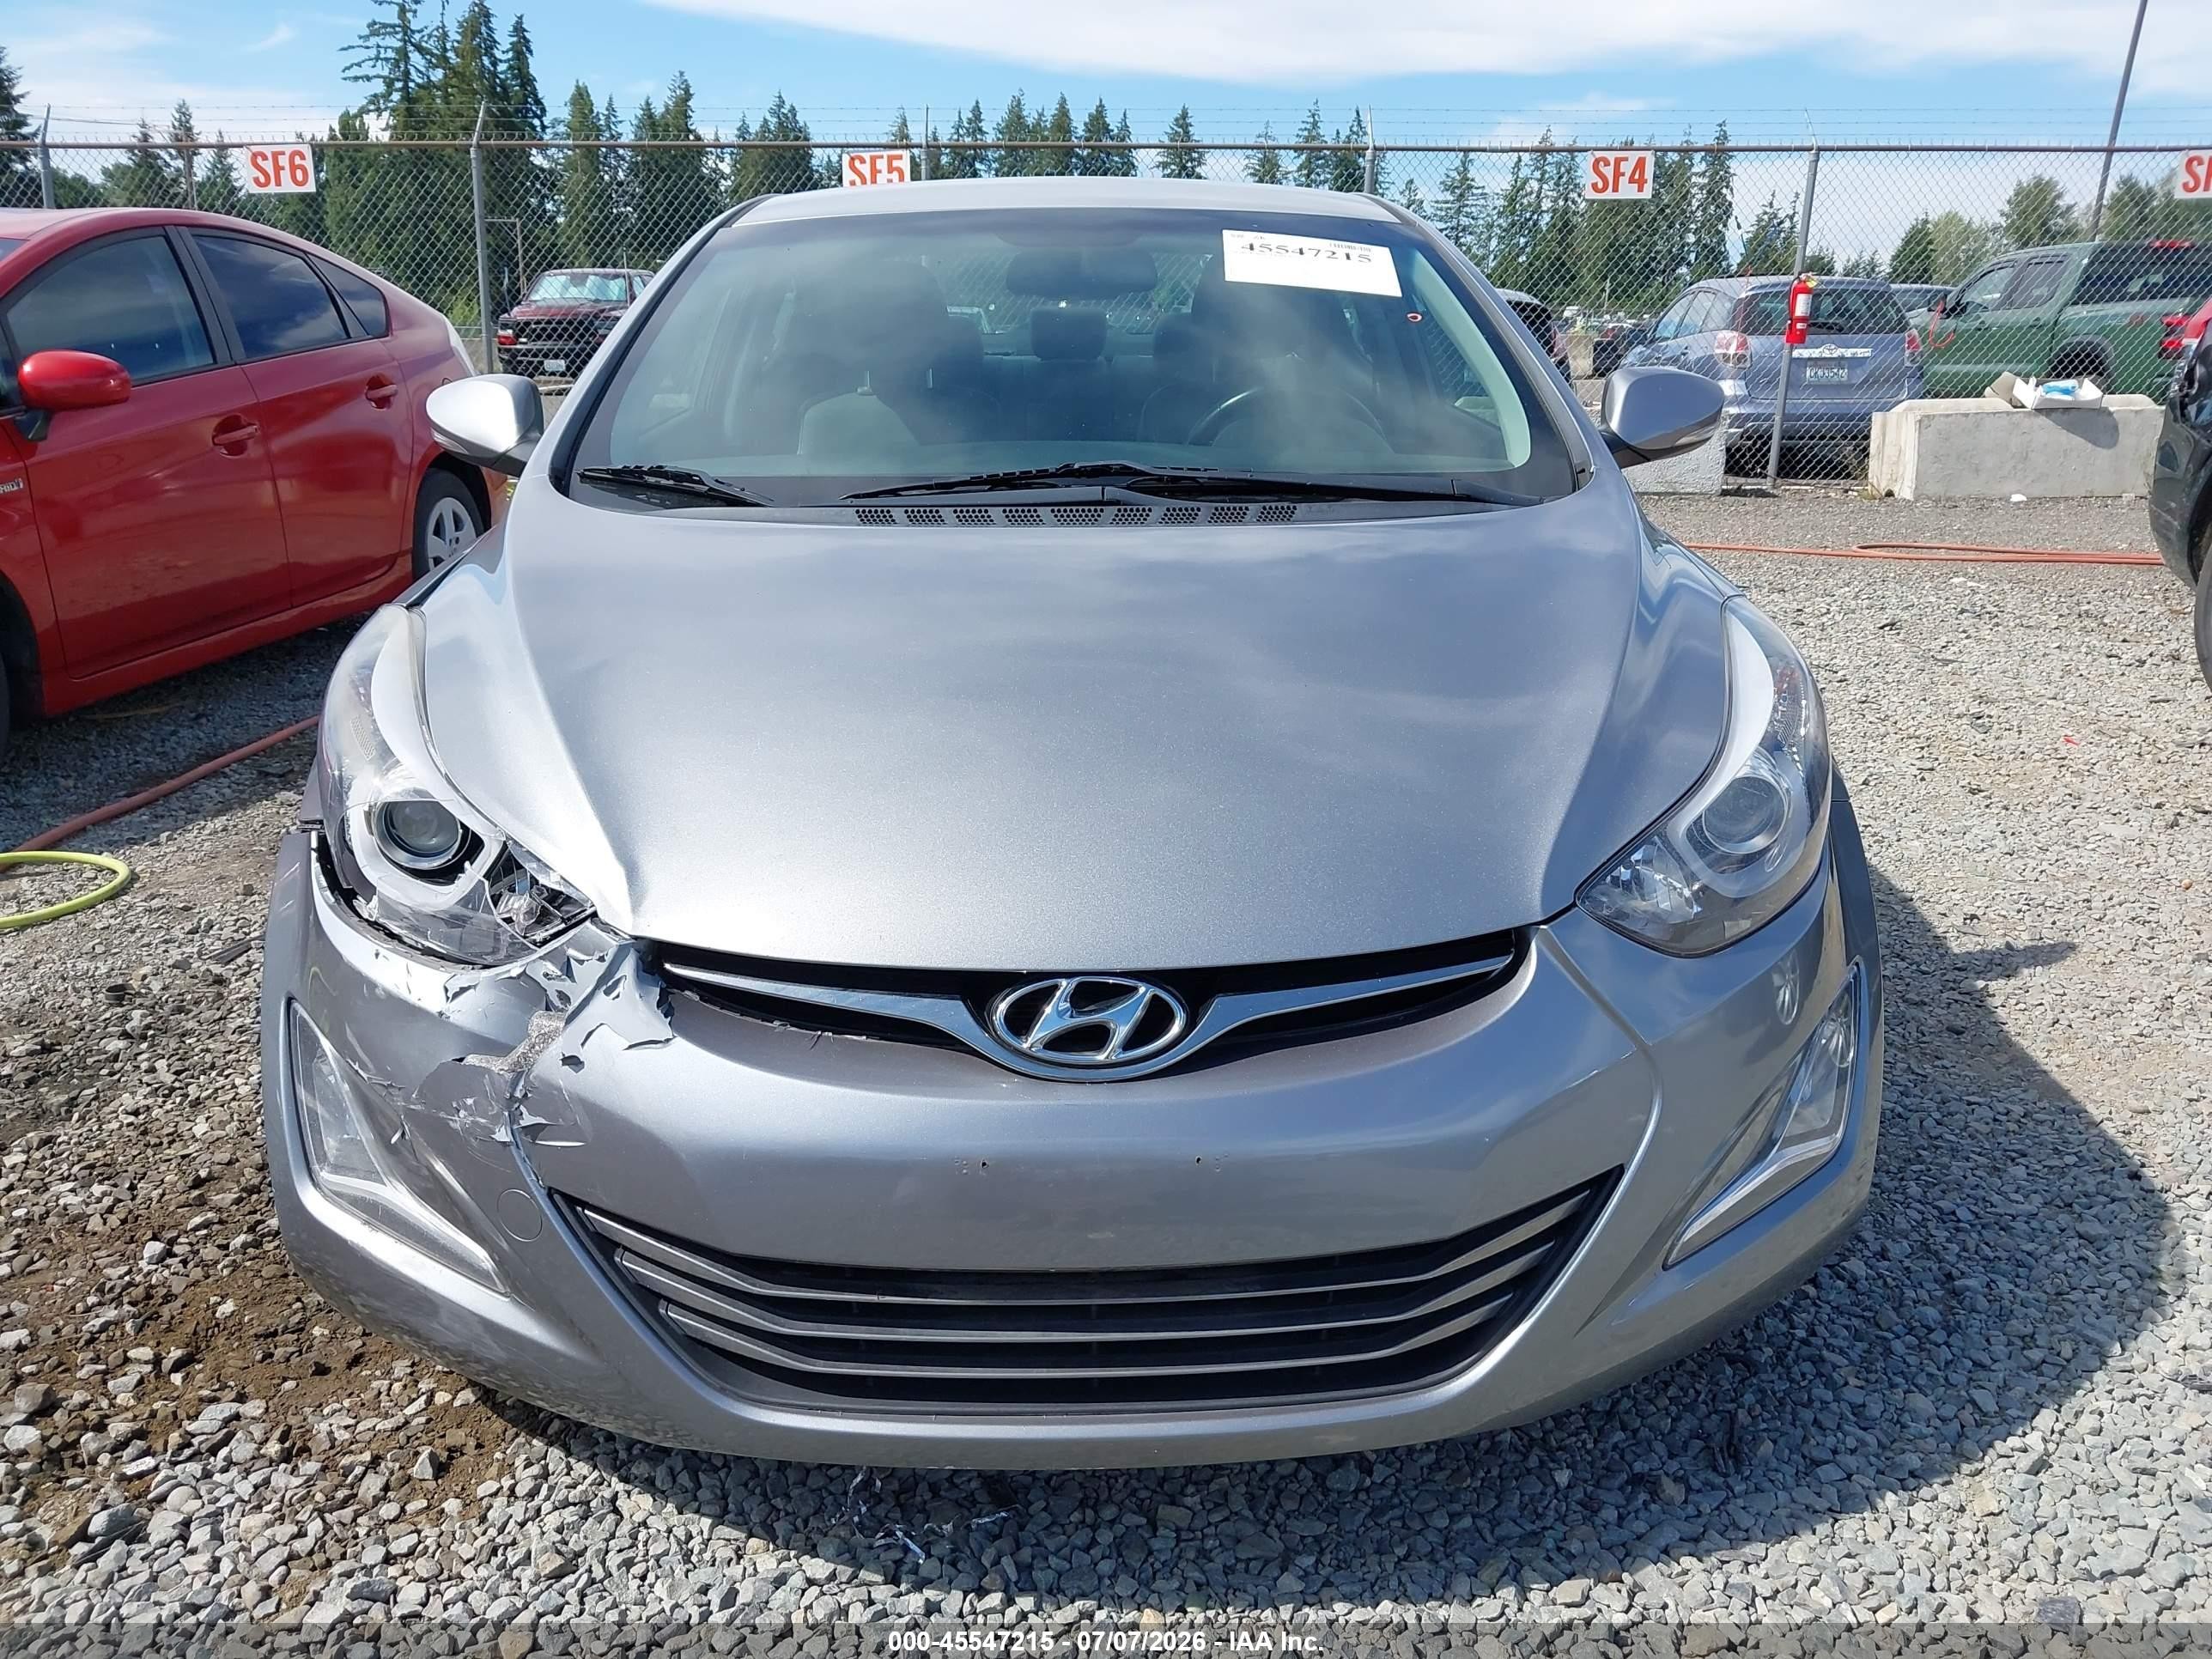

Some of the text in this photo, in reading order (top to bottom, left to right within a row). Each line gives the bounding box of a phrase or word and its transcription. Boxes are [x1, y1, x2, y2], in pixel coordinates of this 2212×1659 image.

[250, 149, 309, 188] SF6
[848, 154, 905, 186] SF5
[1590, 155, 1648, 194] SF4
[1241, 242, 1372, 263] 45547215
